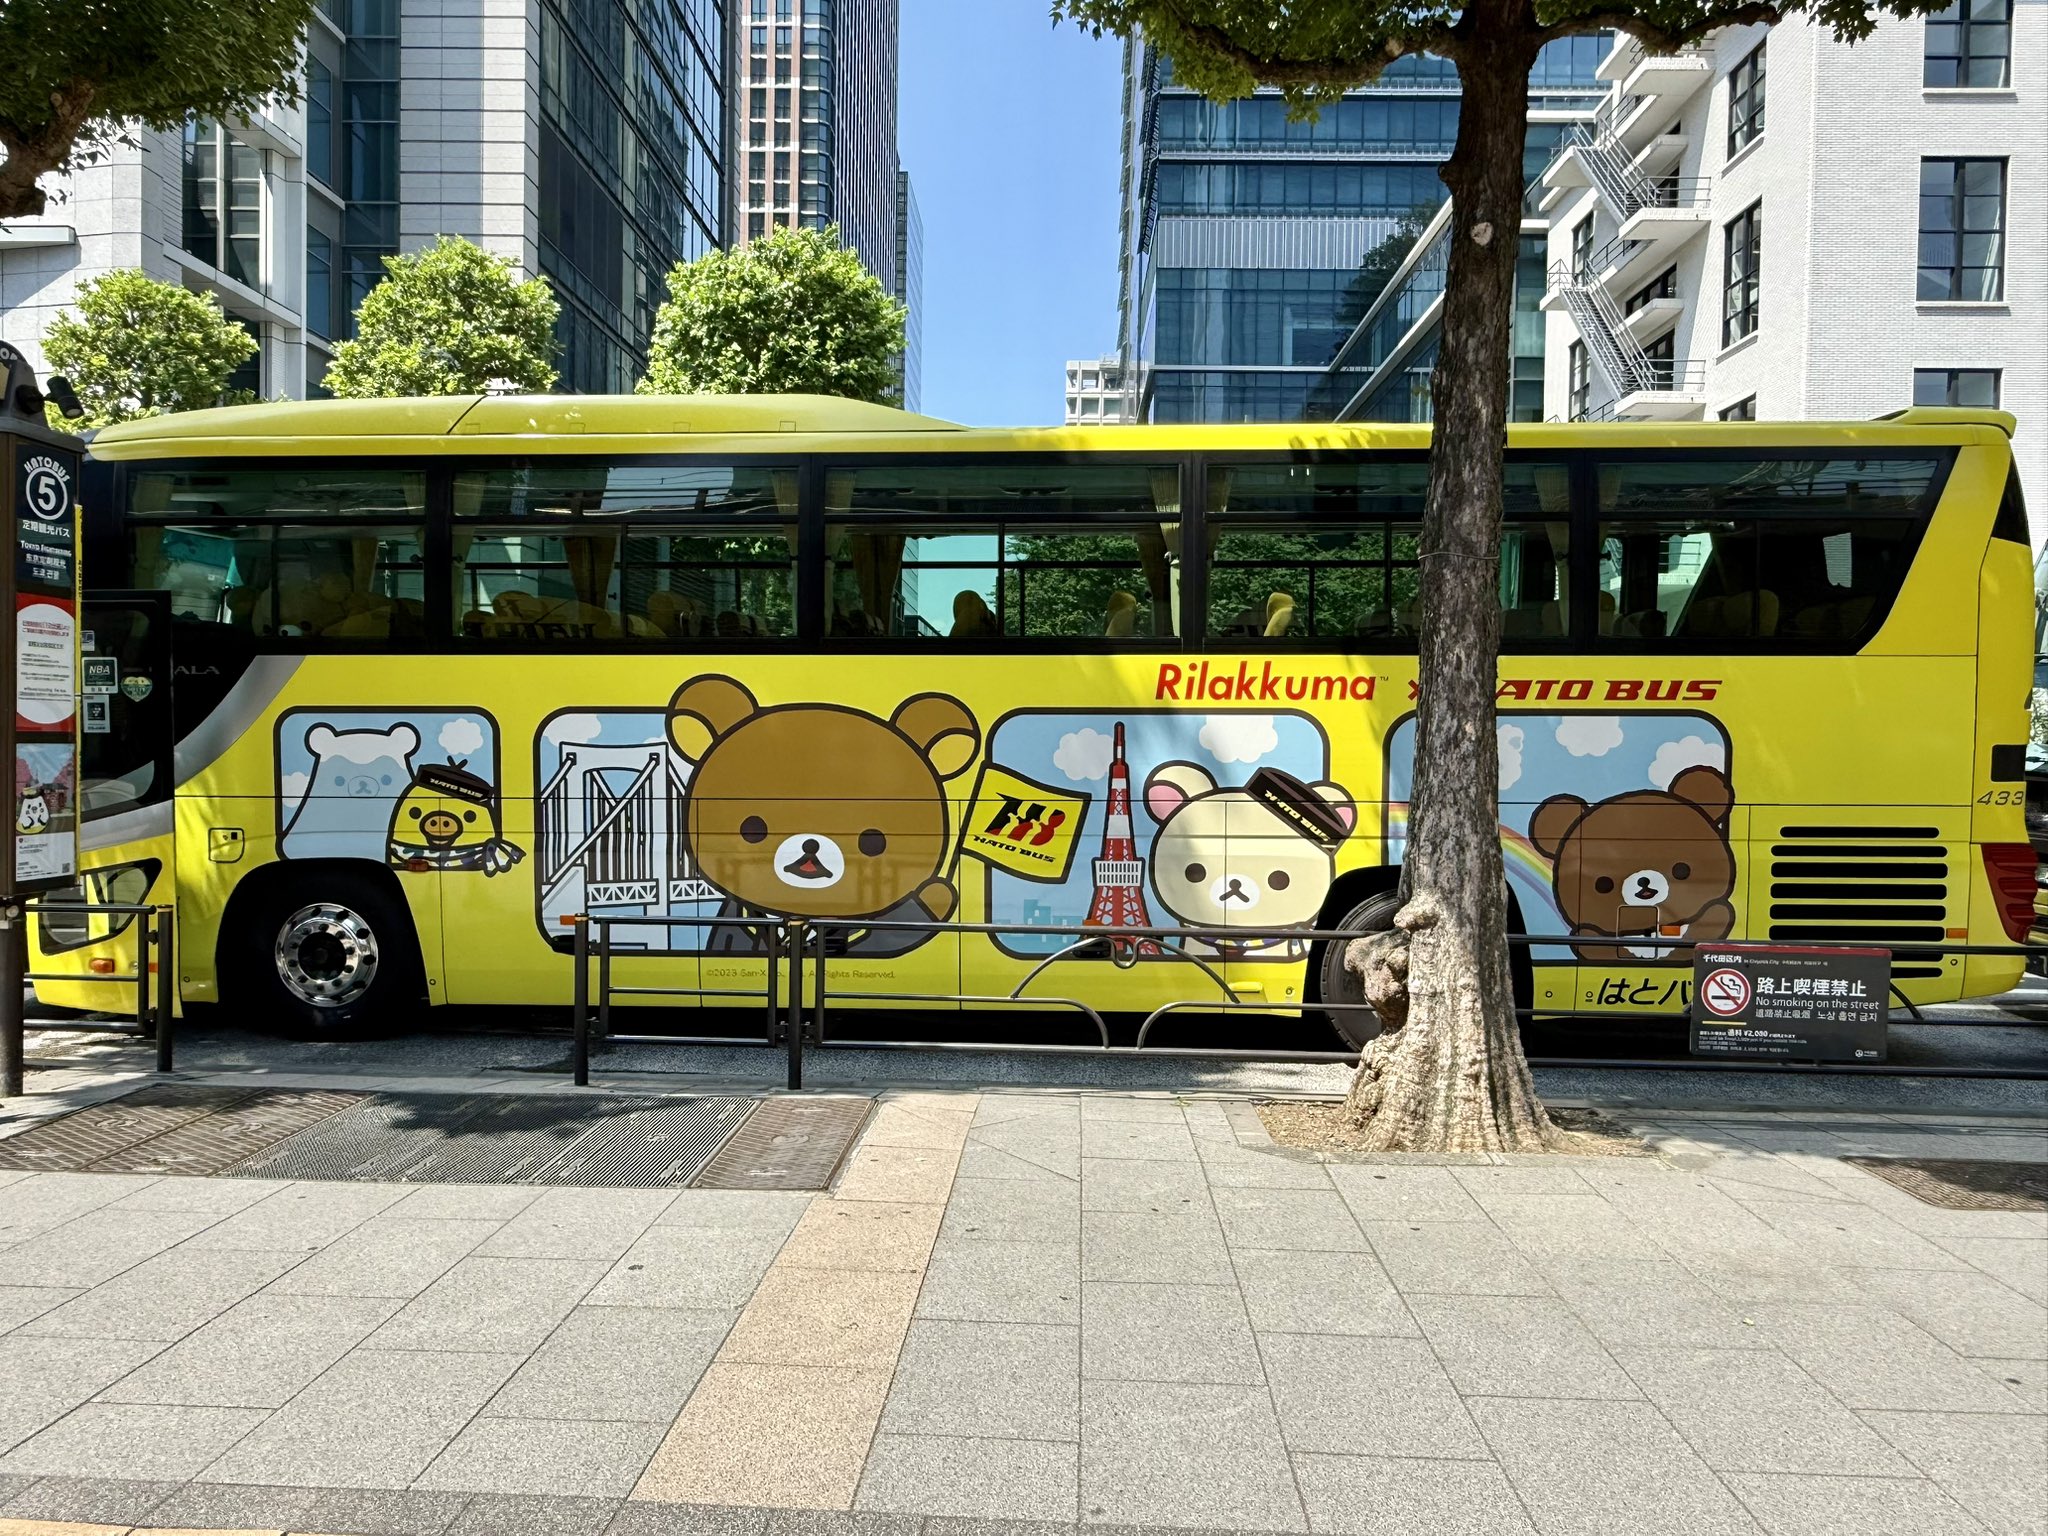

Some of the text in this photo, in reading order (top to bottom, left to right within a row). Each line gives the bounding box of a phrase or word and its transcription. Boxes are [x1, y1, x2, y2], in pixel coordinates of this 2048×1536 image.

[37, 476, 56, 511] 5
[89, 665, 111, 675] NBA
[174, 665, 221, 675] ALA
[1156, 661, 1376, 701] Rilakkuma
[1494, 680, 1594, 701] ATO
[1603, 680, 1723, 701] BUS
[1977, 790, 2025, 806] 433
[973, 835, 1057, 863] HATO BUS
[1597, 978, 1693, 1006] はとバ
[1756, 976, 1867, 998] 路上喫煙禁止
[1755, 997, 1879, 1010] No smoking on the street
[1859, 1012, 1878, 1023] 금지
